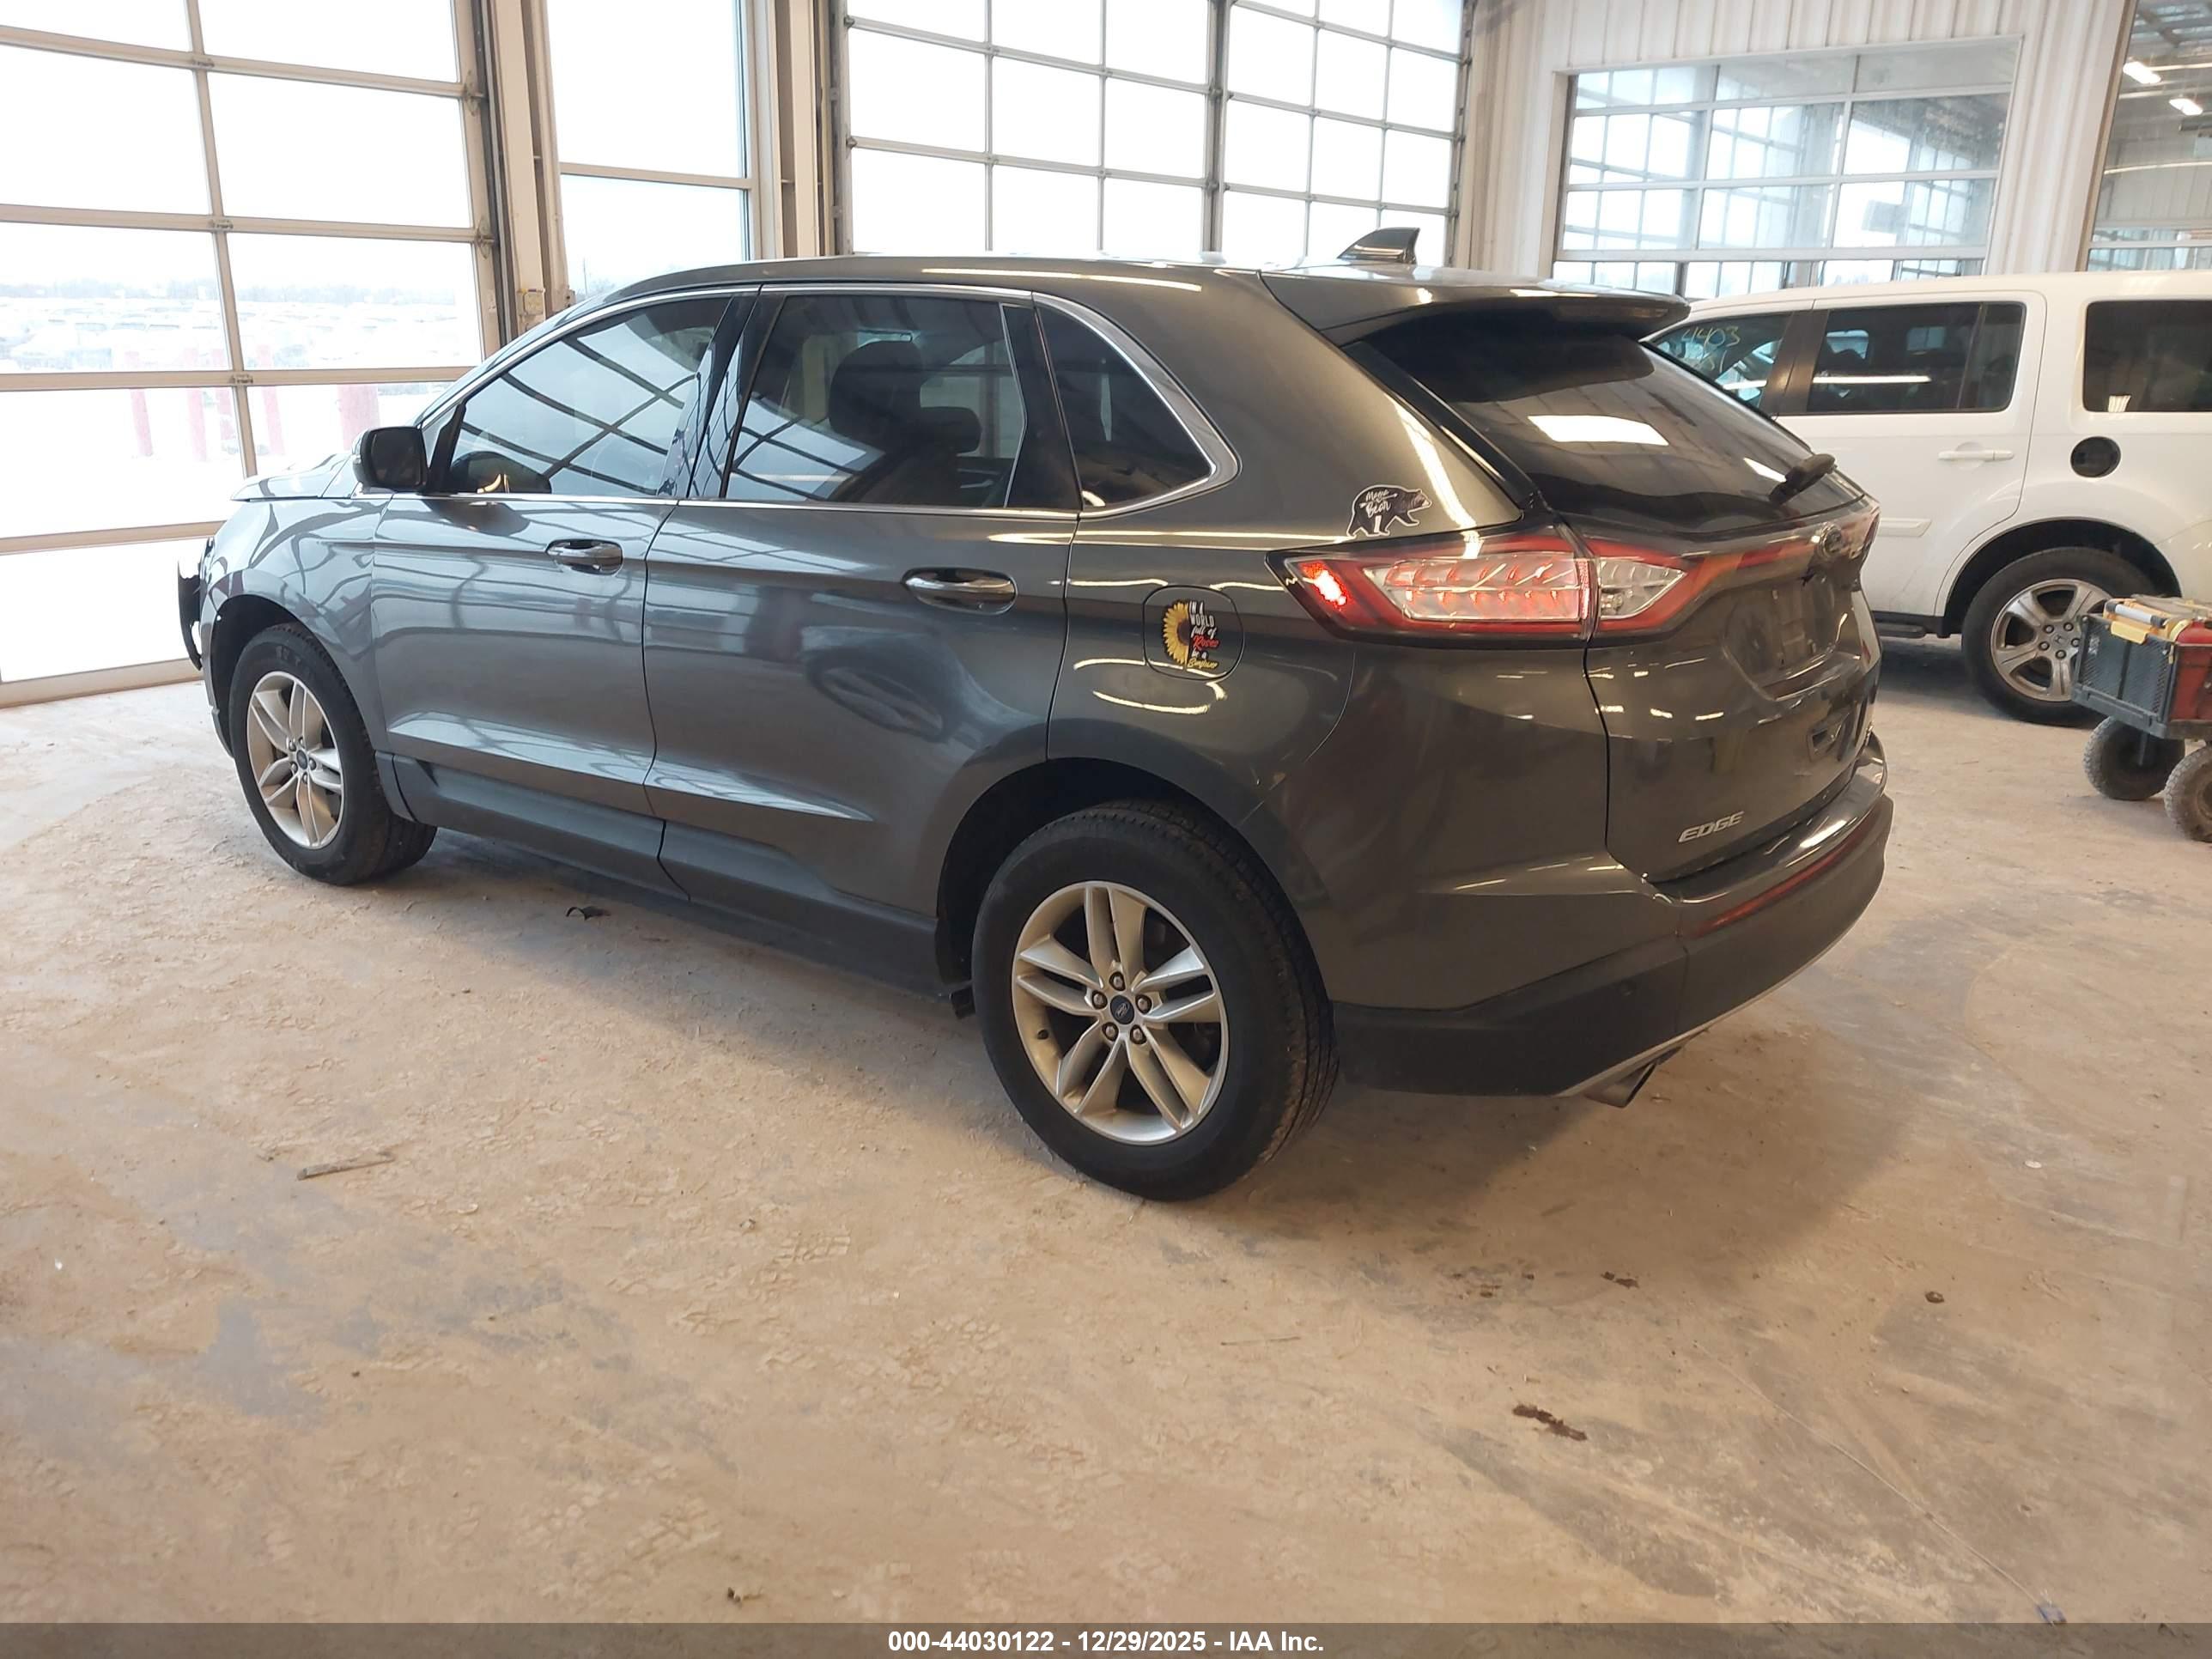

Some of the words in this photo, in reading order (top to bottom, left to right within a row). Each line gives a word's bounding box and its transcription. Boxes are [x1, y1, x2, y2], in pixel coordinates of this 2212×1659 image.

[1365, 501, 1391, 518] Bear
[1189, 600, 1197, 614] IN
[1199, 601, 1204, 614] A
[1190, 613, 1215, 628] WORLD
[1190, 626, 1205, 638] full
[1207, 627, 1217, 640] of
[1678, 811, 1745, 843] EDGE
